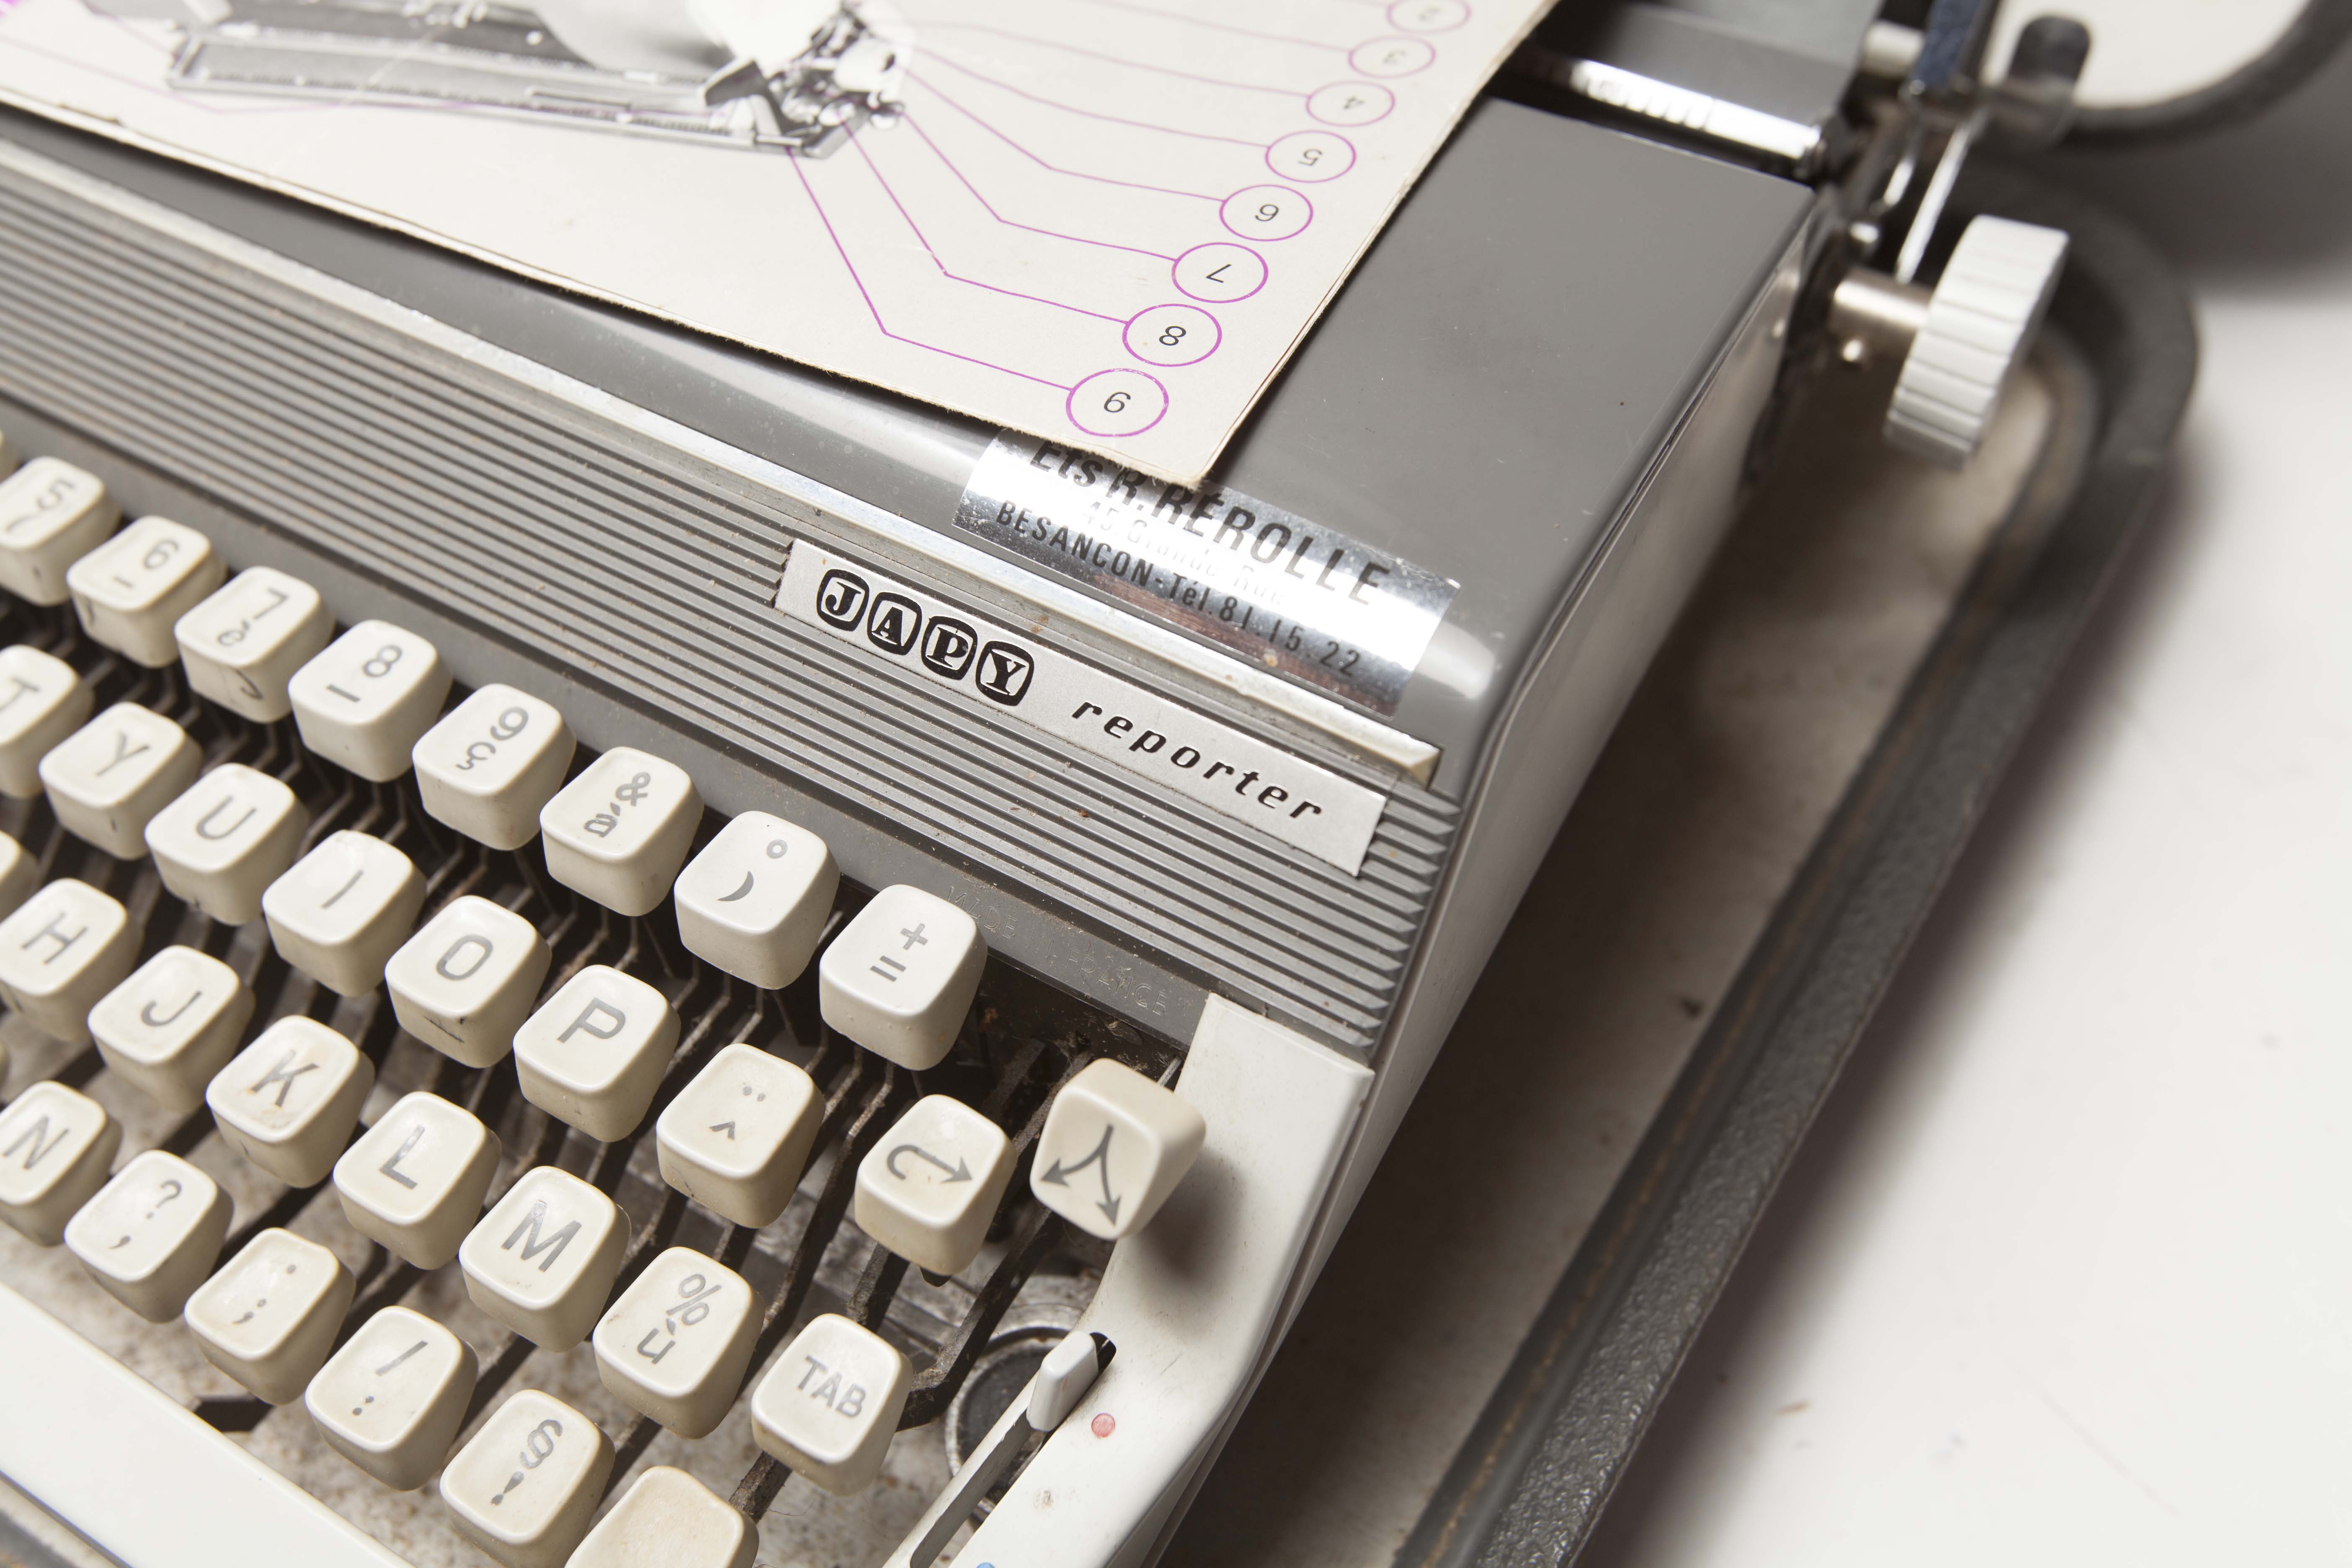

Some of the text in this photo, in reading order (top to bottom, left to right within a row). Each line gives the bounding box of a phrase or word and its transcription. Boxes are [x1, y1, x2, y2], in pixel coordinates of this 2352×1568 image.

[1299, 150, 1322, 166] 5
[1255, 204, 1279, 222] 6
[1206, 264, 1231, 283] 7
[1159, 326, 1186, 346] 8
[36, 477, 76, 510] 5
[142, 539, 180, 570] 6
[253, 588, 289, 620] 7
[362, 645, 402, 678] 8
[0, 677, 40, 712] T
[822, 575, 1323, 822] JAPY reporter
[490, 707, 529, 741] 9
[95, 730, 151, 777] Y
[456, 742, 496, 770] ç
[615, 772, 651, 807] &
[195, 797, 258, 841] U
[583, 802, 620, 838] à
[21, 910, 88, 965] H
[900, 923, 928, 950] +
[436, 936, 493, 981] O
[870, 956, 906, 982] =
[140, 991, 204, 1029] J
[557, 998, 626, 1043] P
[249, 1050, 320, 1108] K
[2, 1117, 71, 1171] N
[379, 1124, 425, 1190] L
[146, 1179, 183, 1219] ?
[500, 1199, 583, 1273] M
[665, 1274, 722, 1327] %
[637, 1319, 675, 1364] ù
[797, 1354, 866, 1419] TAB
[521, 1419, 562, 1469] §
[490, 1471, 525, 1506] !
